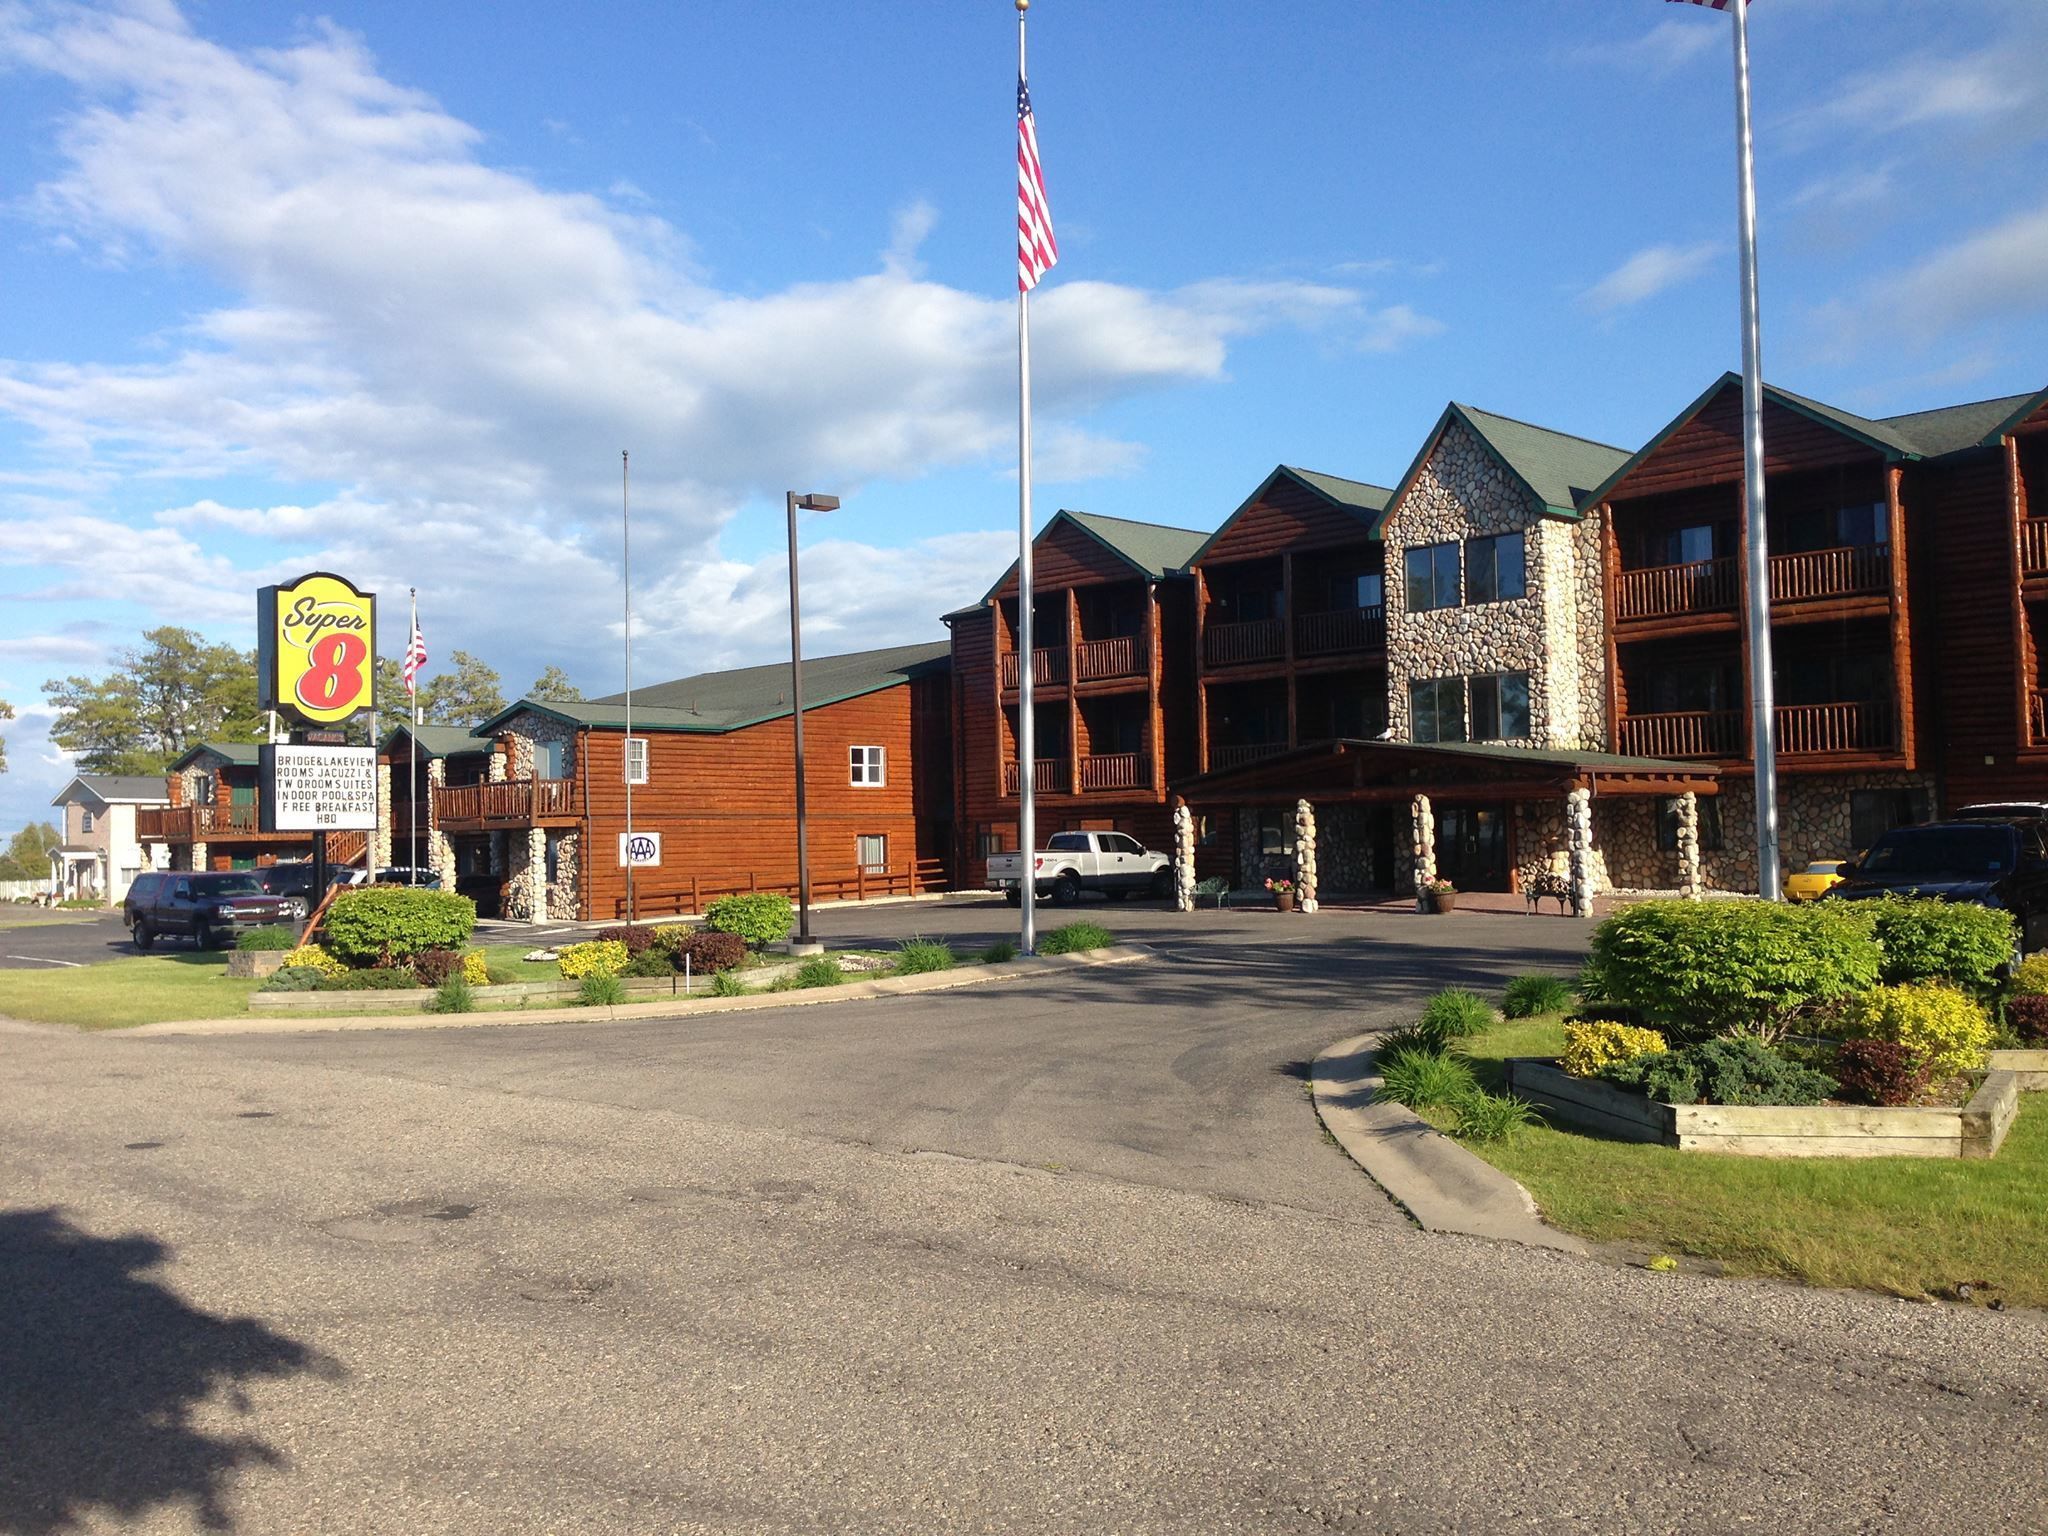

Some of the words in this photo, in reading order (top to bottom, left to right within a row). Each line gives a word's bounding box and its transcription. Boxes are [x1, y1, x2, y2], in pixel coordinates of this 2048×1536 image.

[284, 596, 367, 643] Super
[295, 633, 367, 710] 8
[277, 768, 314, 777] ROOMS
[318, 769, 361, 777] JACUZZI
[365, 769, 371, 778] &
[278, 791, 317, 800] INDOOR
[316, 803, 374, 812] BREAKFAST
[630, 838, 652, 860] AAA
